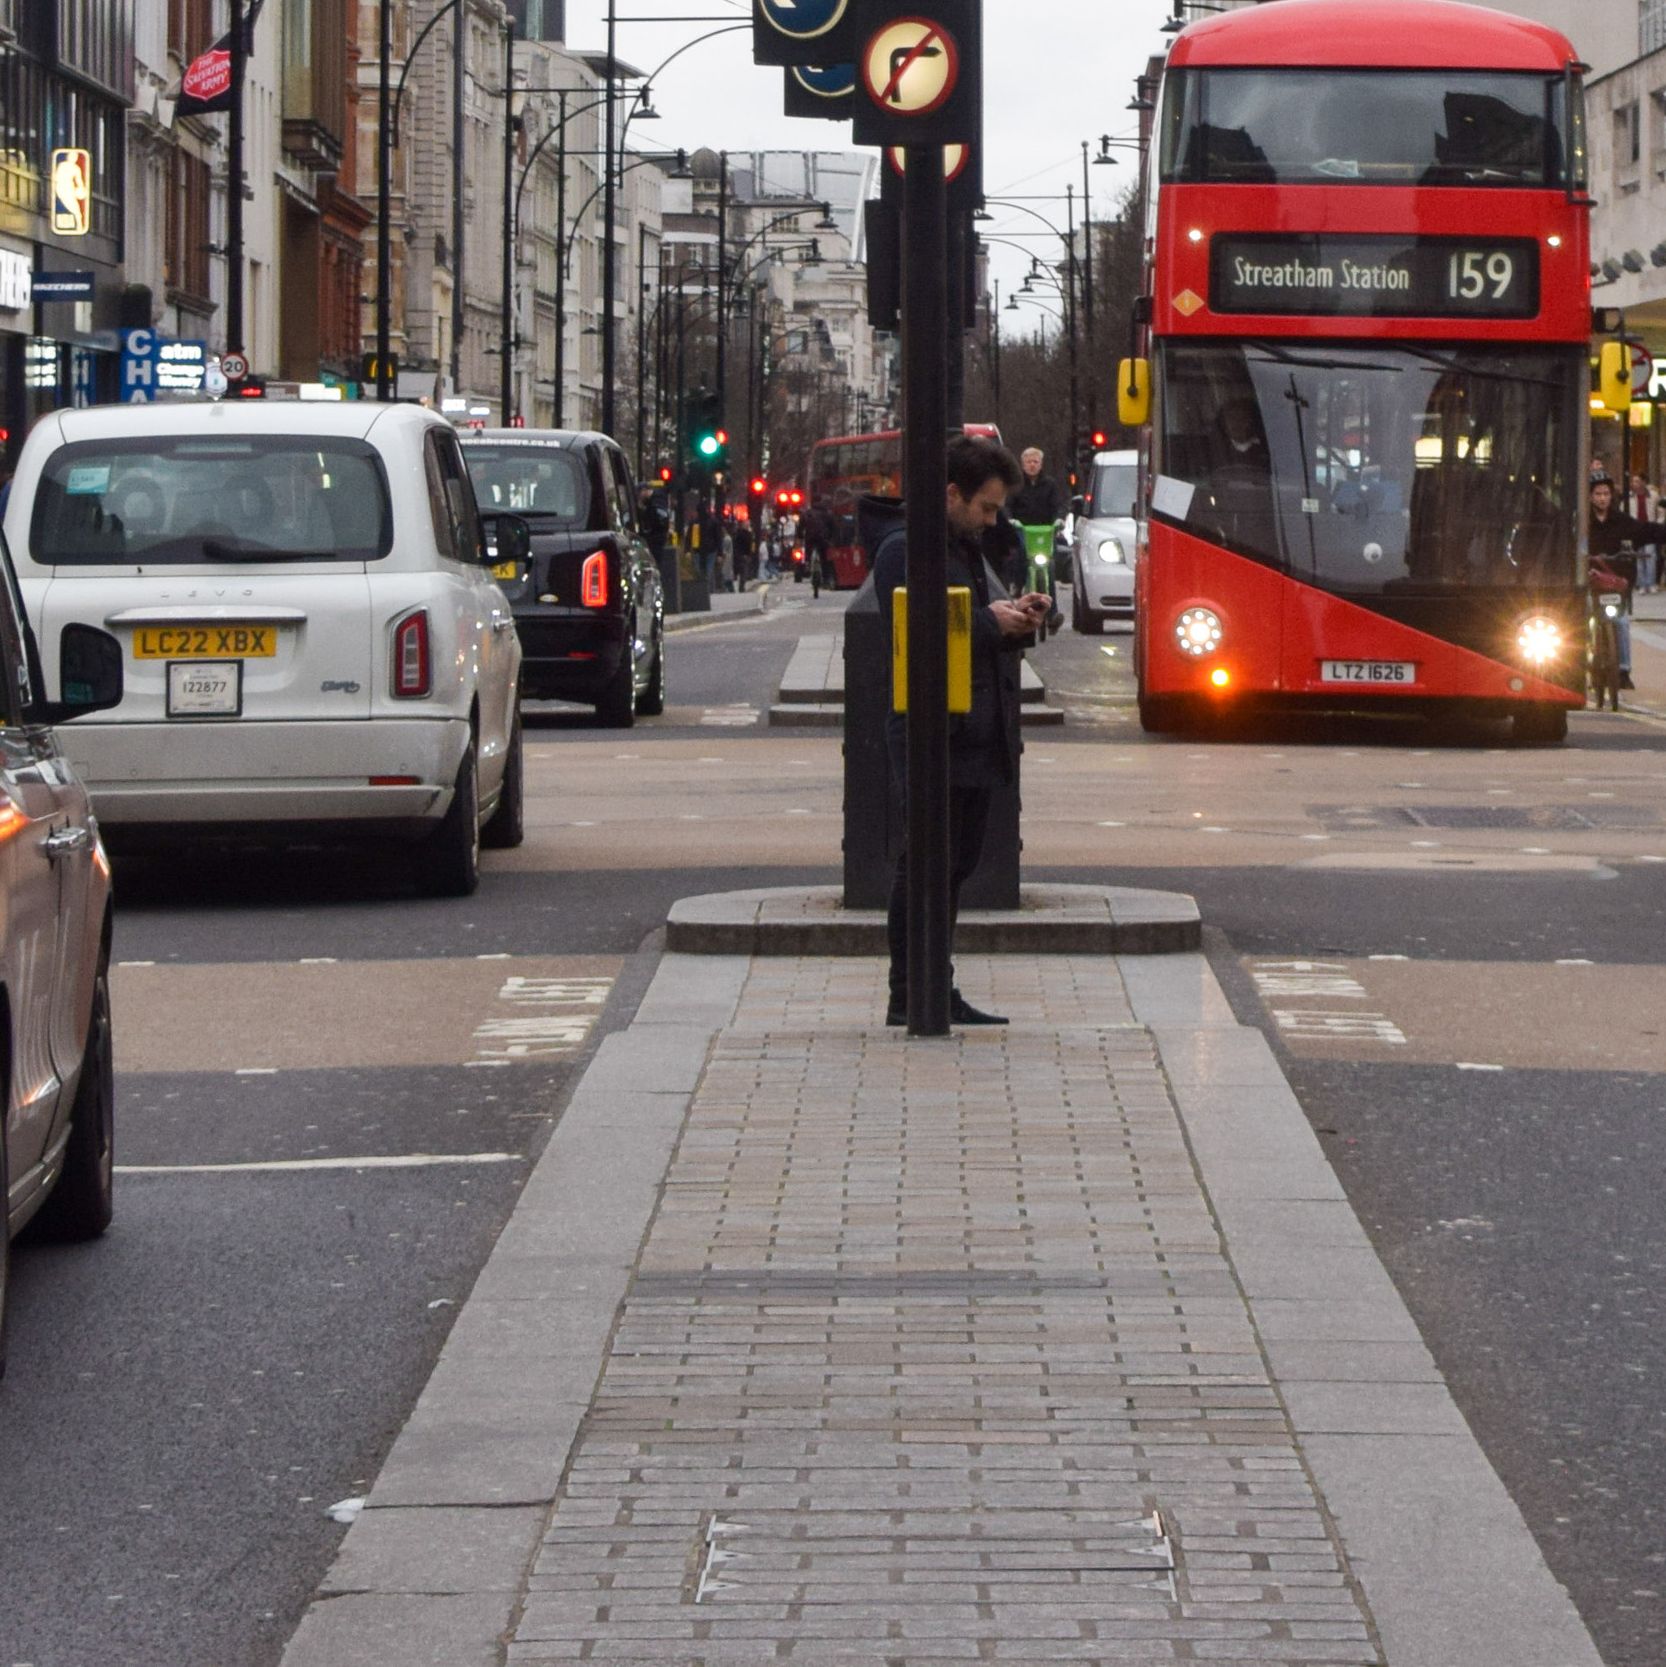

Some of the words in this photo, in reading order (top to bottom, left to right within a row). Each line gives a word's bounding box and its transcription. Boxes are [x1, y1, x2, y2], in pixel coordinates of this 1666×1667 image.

[198, 56, 214, 70] THE
[201, 74, 226, 91] ARMY
[1234, 255, 1334, 289] Streatham
[1340, 258, 1410, 290] Station
[1448, 251, 1514, 299] 159
[159, 343, 203, 360] atm
[156, 362, 206, 377] Change
[223, 360, 245, 373] 20
[158, 375, 202, 389] Money
[141, 630, 208, 655] LC22
[216, 629, 266, 654] XBX
[1332, 663, 1364, 680] LTZ
[1368, 664, 1405, 681] 1626
[182, 680, 228, 694] 122877
